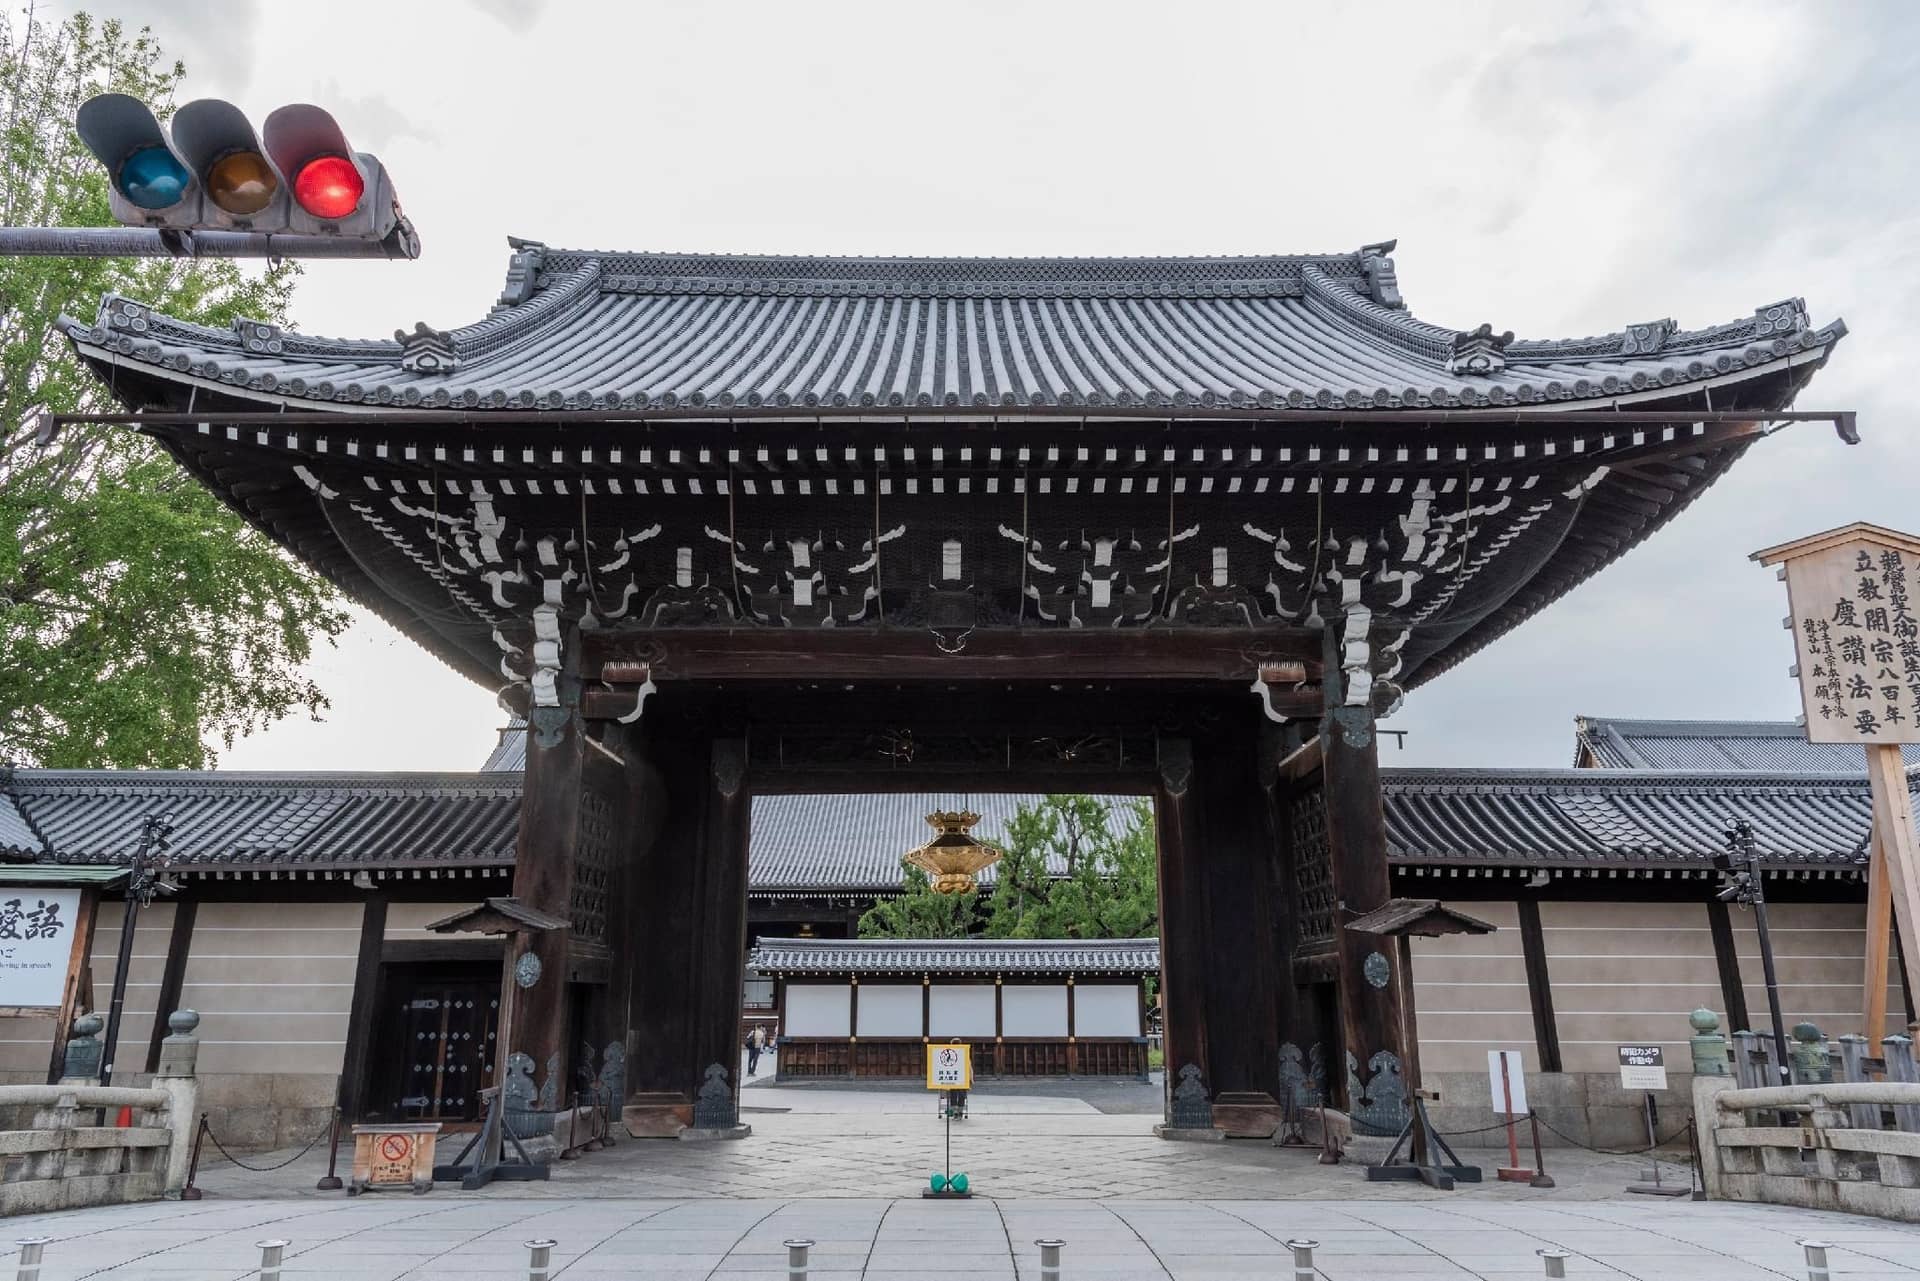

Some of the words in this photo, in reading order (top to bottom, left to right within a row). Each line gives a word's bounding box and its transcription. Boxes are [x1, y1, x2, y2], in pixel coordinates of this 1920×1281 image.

[1854, 550, 1906, 725] 立教開宗八百年
[29, 962, 52, 970] speech
